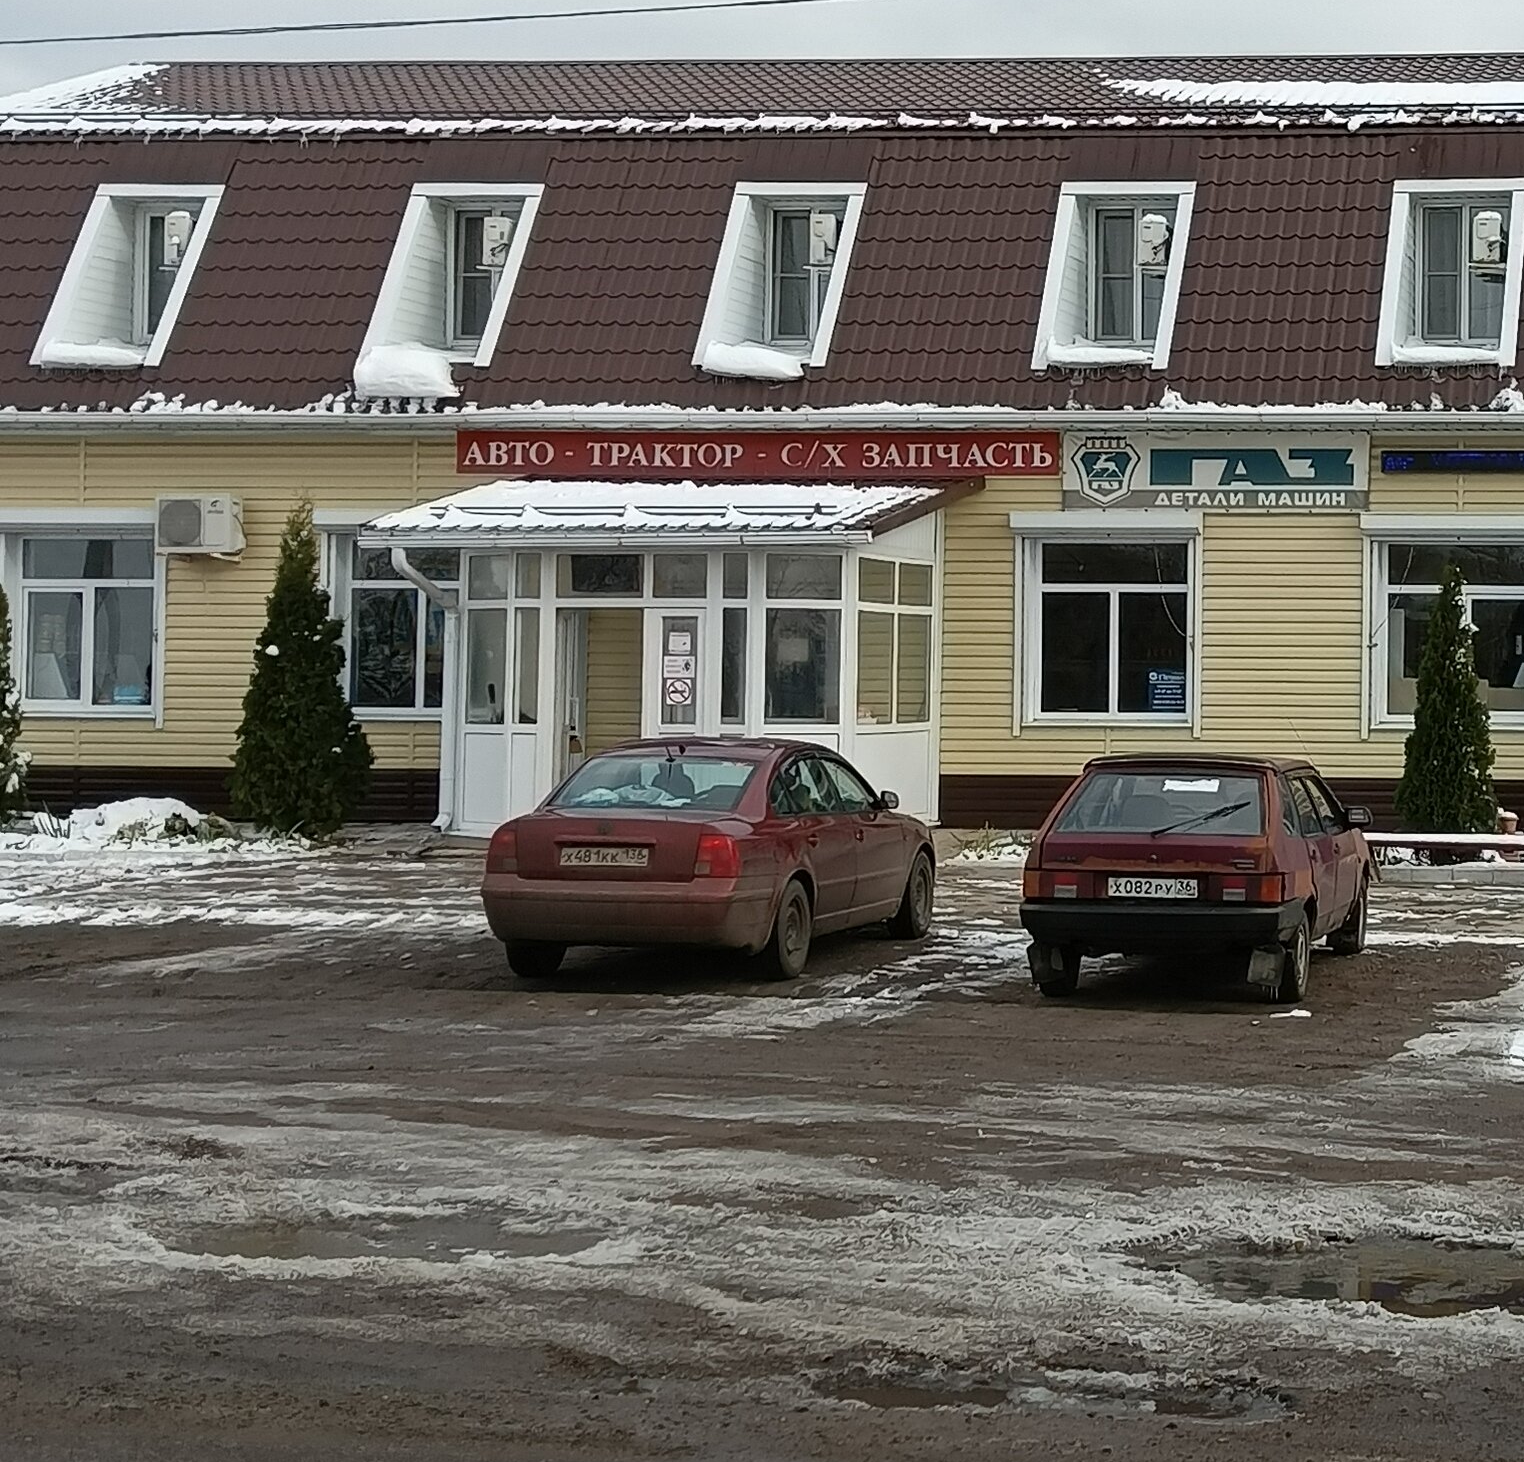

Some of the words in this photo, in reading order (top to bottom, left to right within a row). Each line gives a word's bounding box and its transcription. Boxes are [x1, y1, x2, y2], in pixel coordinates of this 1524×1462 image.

[462, 441, 555, 466] АВТО
[586, 442, 744, 468] ТРАКТОР
[780, 440, 848, 468] С/Х
[862, 442, 1053, 468] ЗАПЧАСТЬ
[1149, 449, 1354, 486] ГАЗ
[1154, 492, 1245, 506] ДЕТАЛИ
[1257, 492, 1346, 506] МАШИН
[1177, 879, 1193, 892] 36
